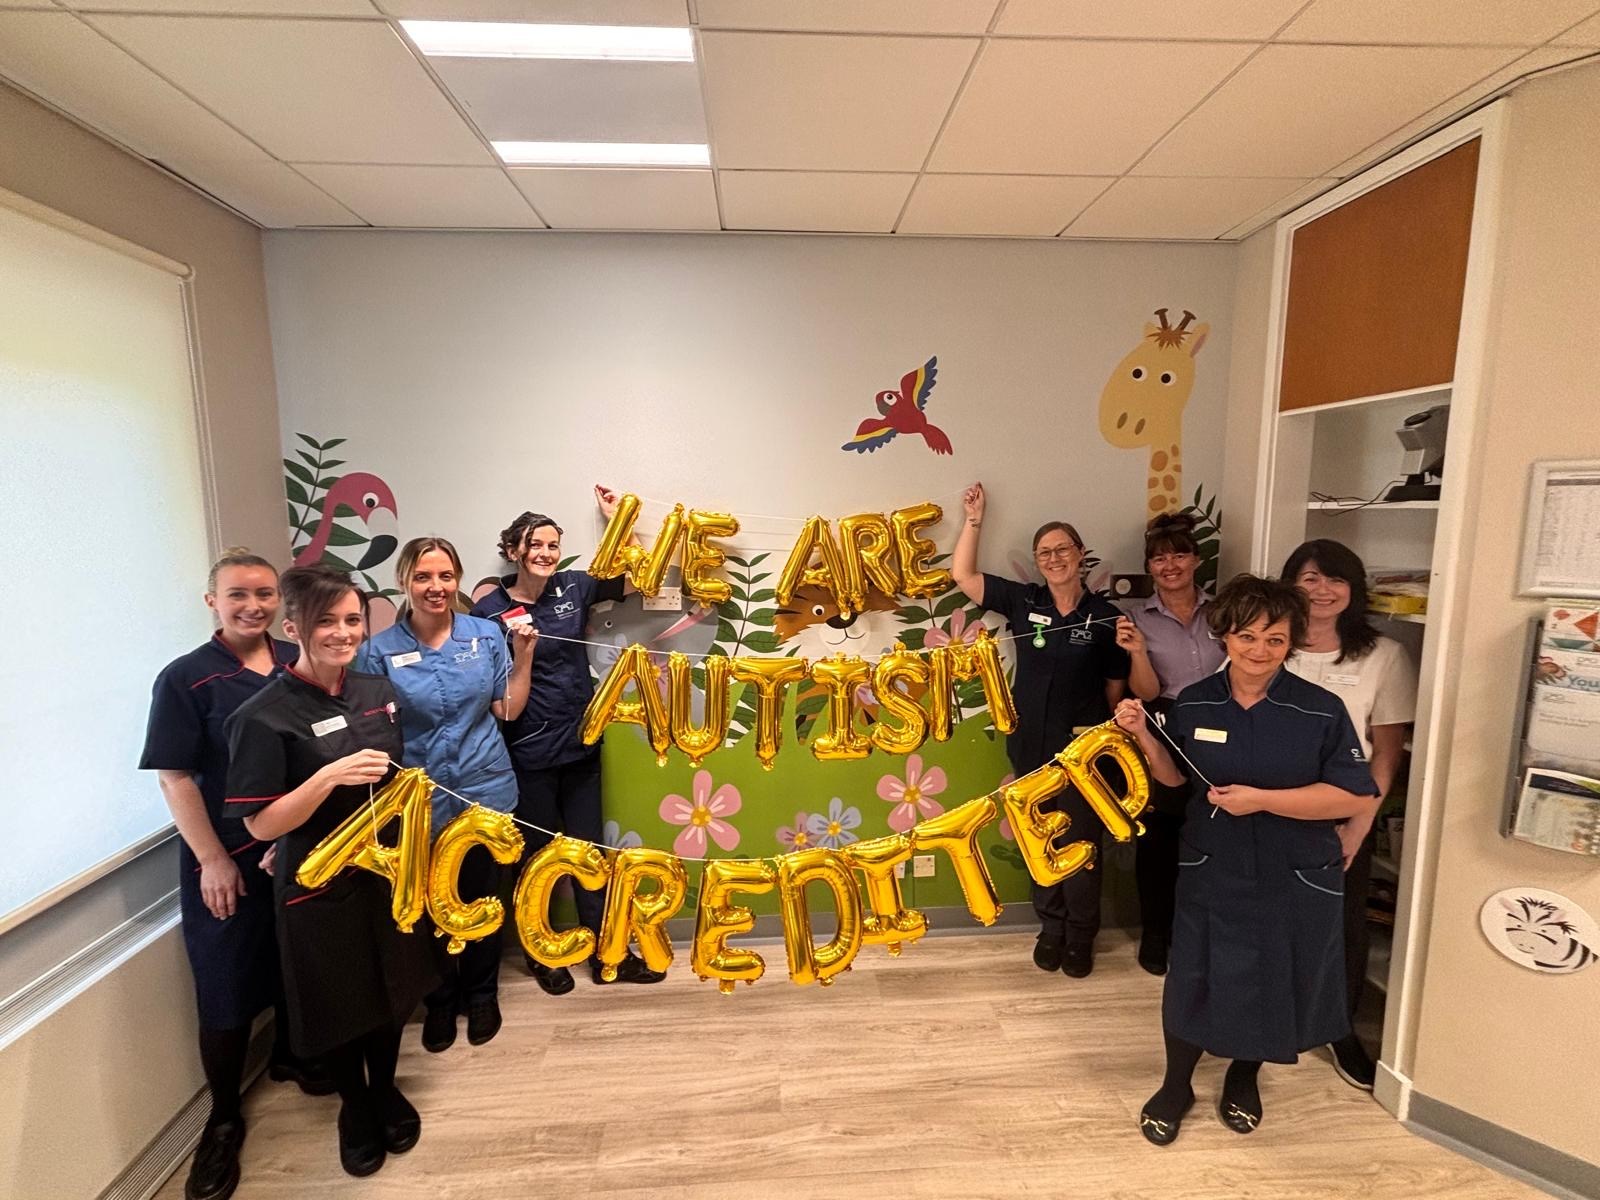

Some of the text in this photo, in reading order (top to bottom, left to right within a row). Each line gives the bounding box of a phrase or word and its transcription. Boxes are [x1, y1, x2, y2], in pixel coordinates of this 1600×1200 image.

[587, 493, 952, 616] WE ARE
[583, 628, 1017, 769] AUTISM
[296, 720, 1152, 990] ACCREDITED
